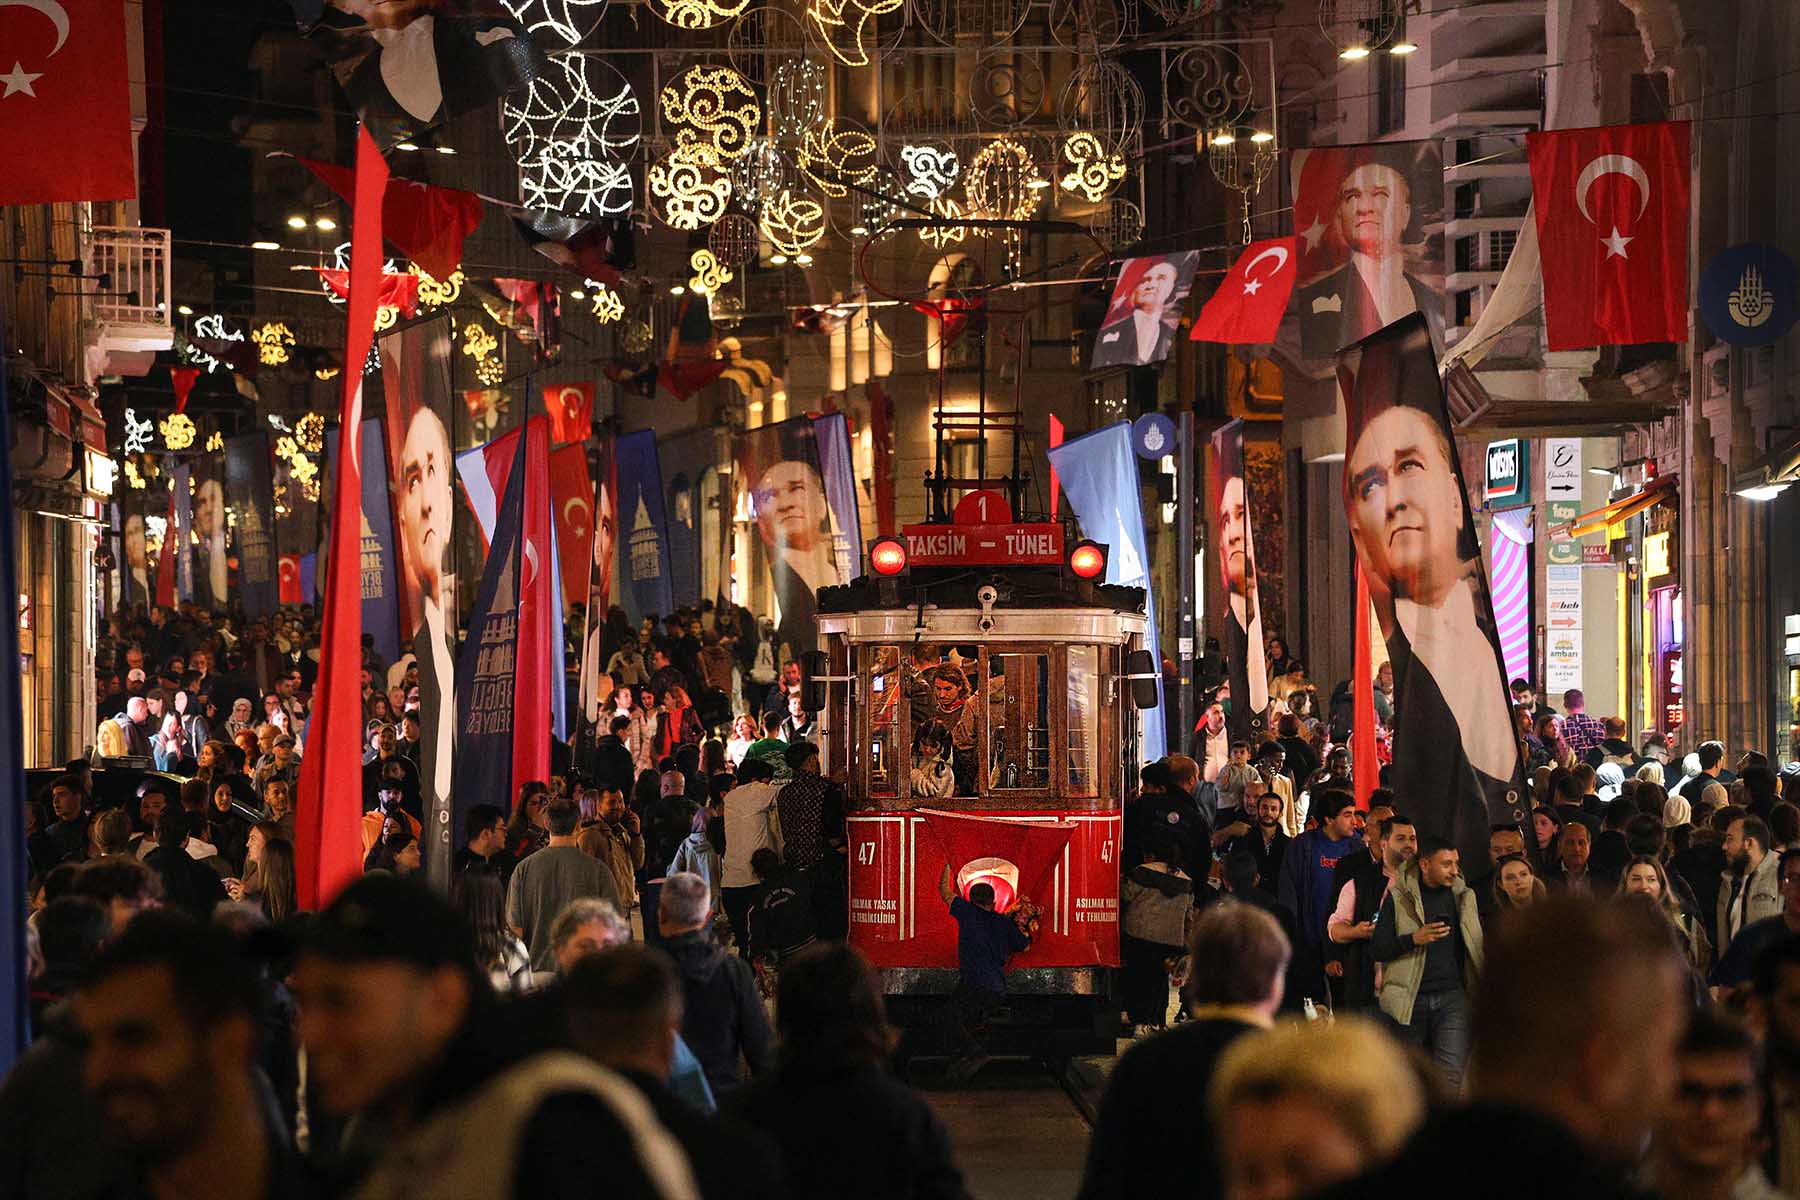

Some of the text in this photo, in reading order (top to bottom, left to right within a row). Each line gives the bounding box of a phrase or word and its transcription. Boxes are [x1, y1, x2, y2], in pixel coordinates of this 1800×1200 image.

[978, 495, 987, 521] 1
[907, 529, 966, 556] TAKSİM
[1005, 529, 1057, 555] TÜNEL
[858, 841, 876, 865] 47
[1101, 840, 1114, 864] 47
[873, 899, 897, 911] YASAK
[1075, 911, 1085, 922] VE
